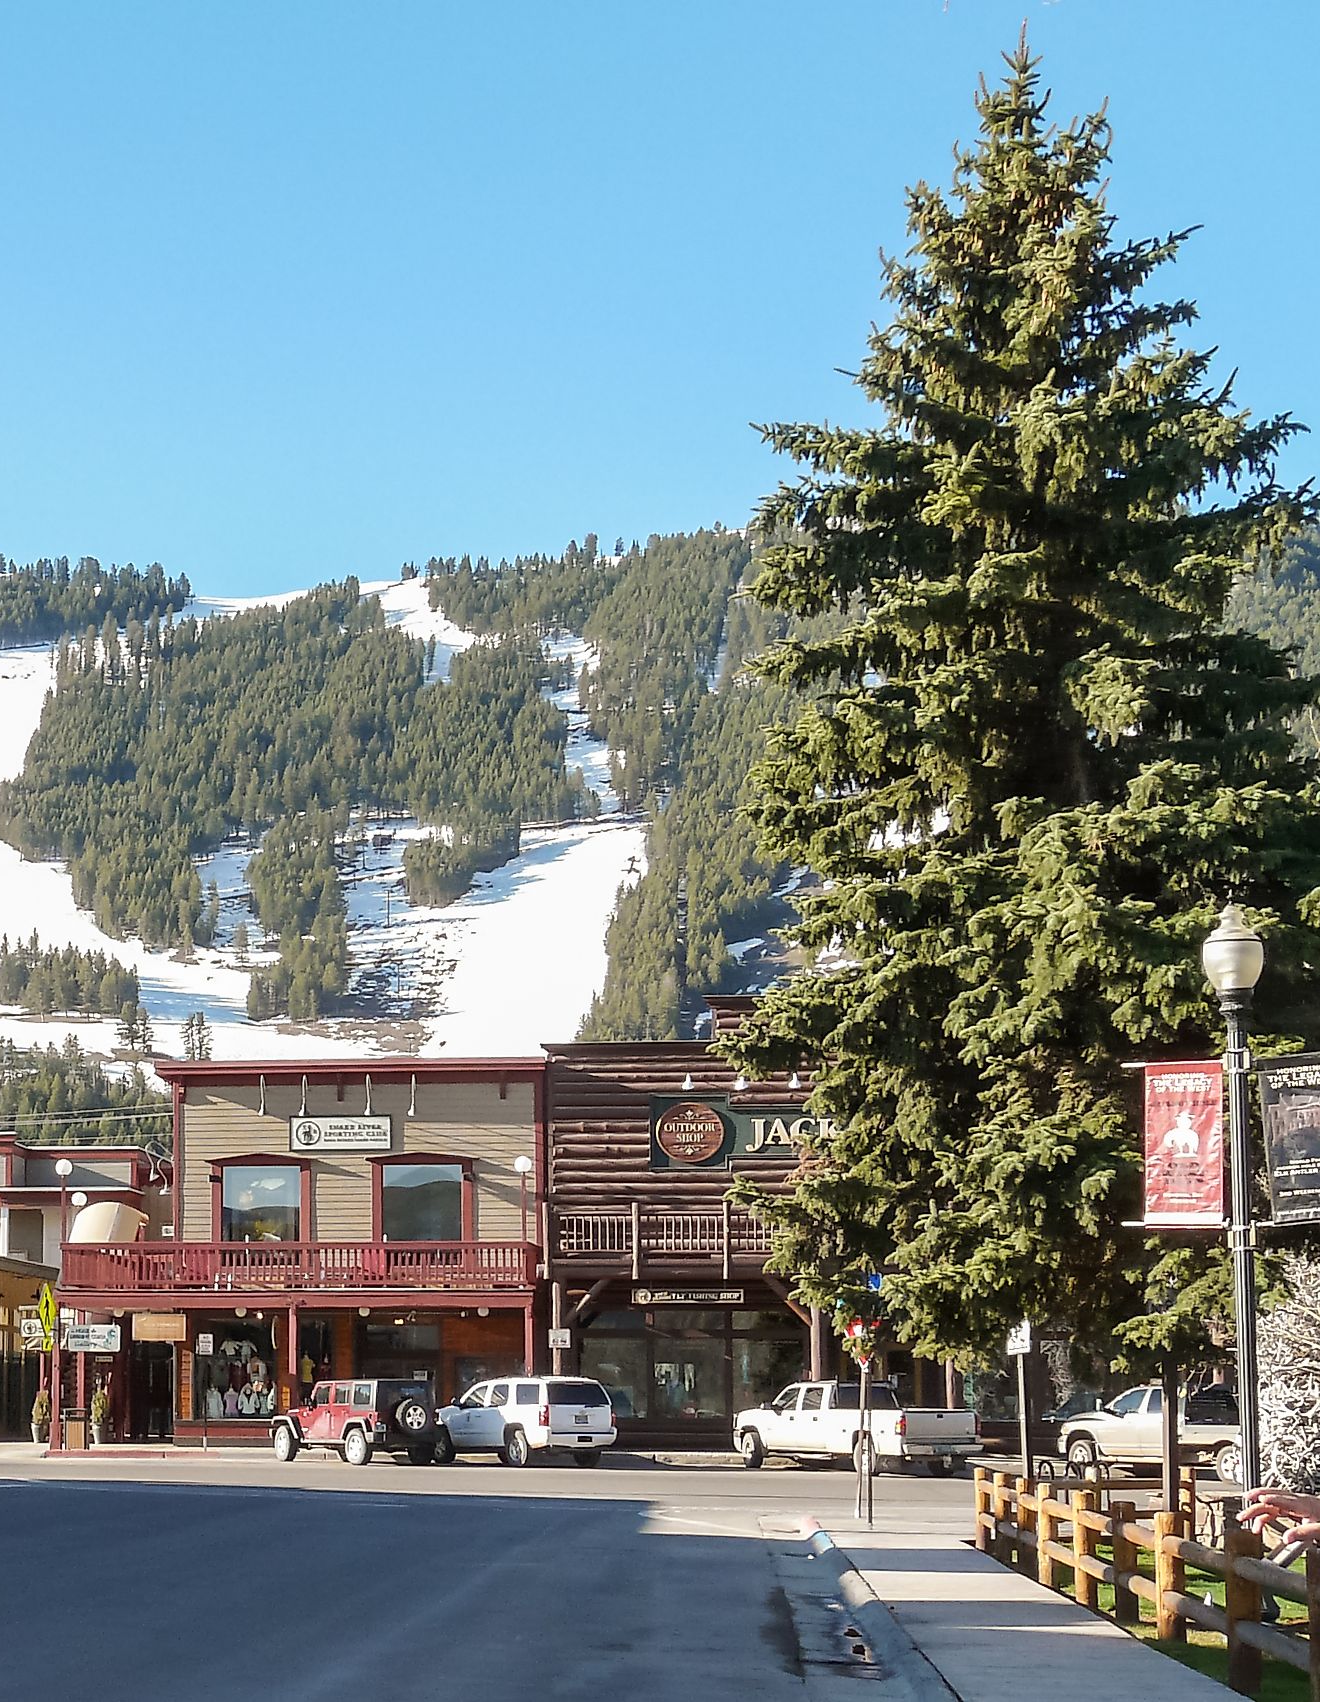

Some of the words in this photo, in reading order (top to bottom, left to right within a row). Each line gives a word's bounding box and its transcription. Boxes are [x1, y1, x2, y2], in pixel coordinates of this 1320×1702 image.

[1152, 1079, 1173, 1088] THE
[1266, 1074, 1290, 1083] THE
[1270, 1082, 1285, 1090] OF
[1286, 1080, 1305, 1088] THE
[663, 1122, 716, 1133] OUTDOOR
[676, 1133, 704, 1143] SHOP
